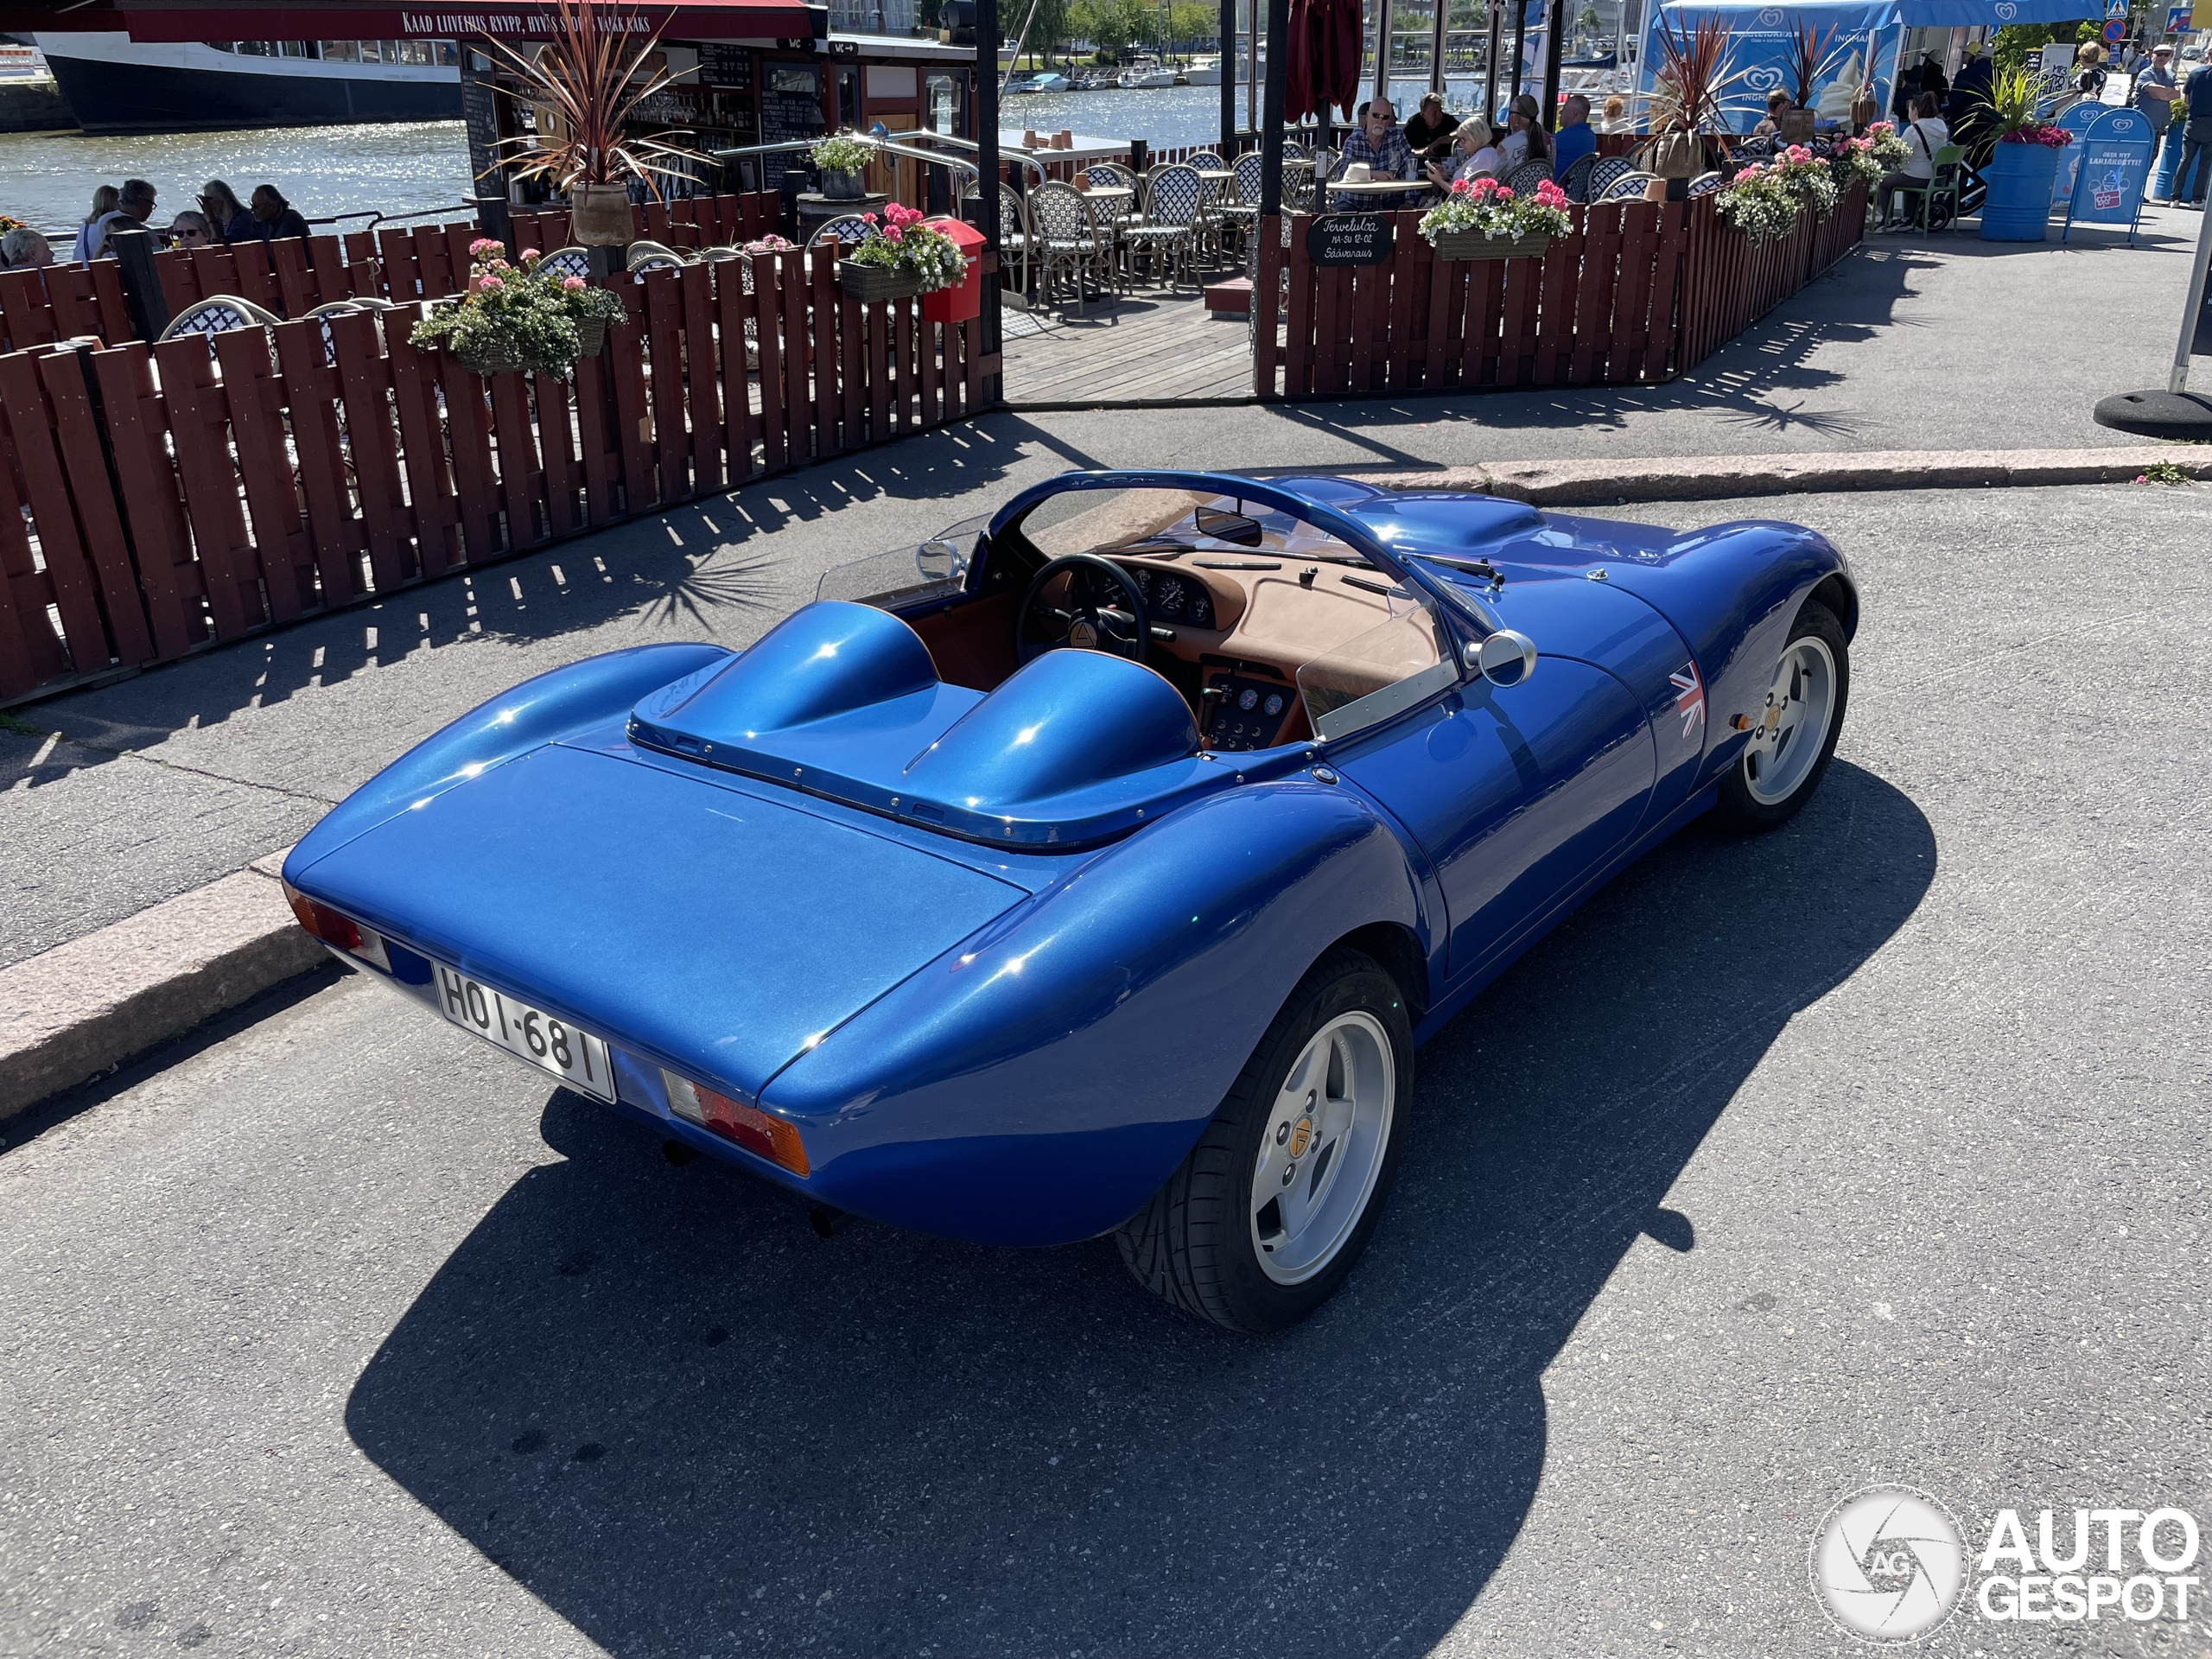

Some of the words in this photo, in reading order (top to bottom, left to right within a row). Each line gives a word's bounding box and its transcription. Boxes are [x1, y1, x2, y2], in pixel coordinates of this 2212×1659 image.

[788, 38, 801, 48] WC
[835, 43, 844, 53] WC
[441, 967, 594, 1082] HOI-681
